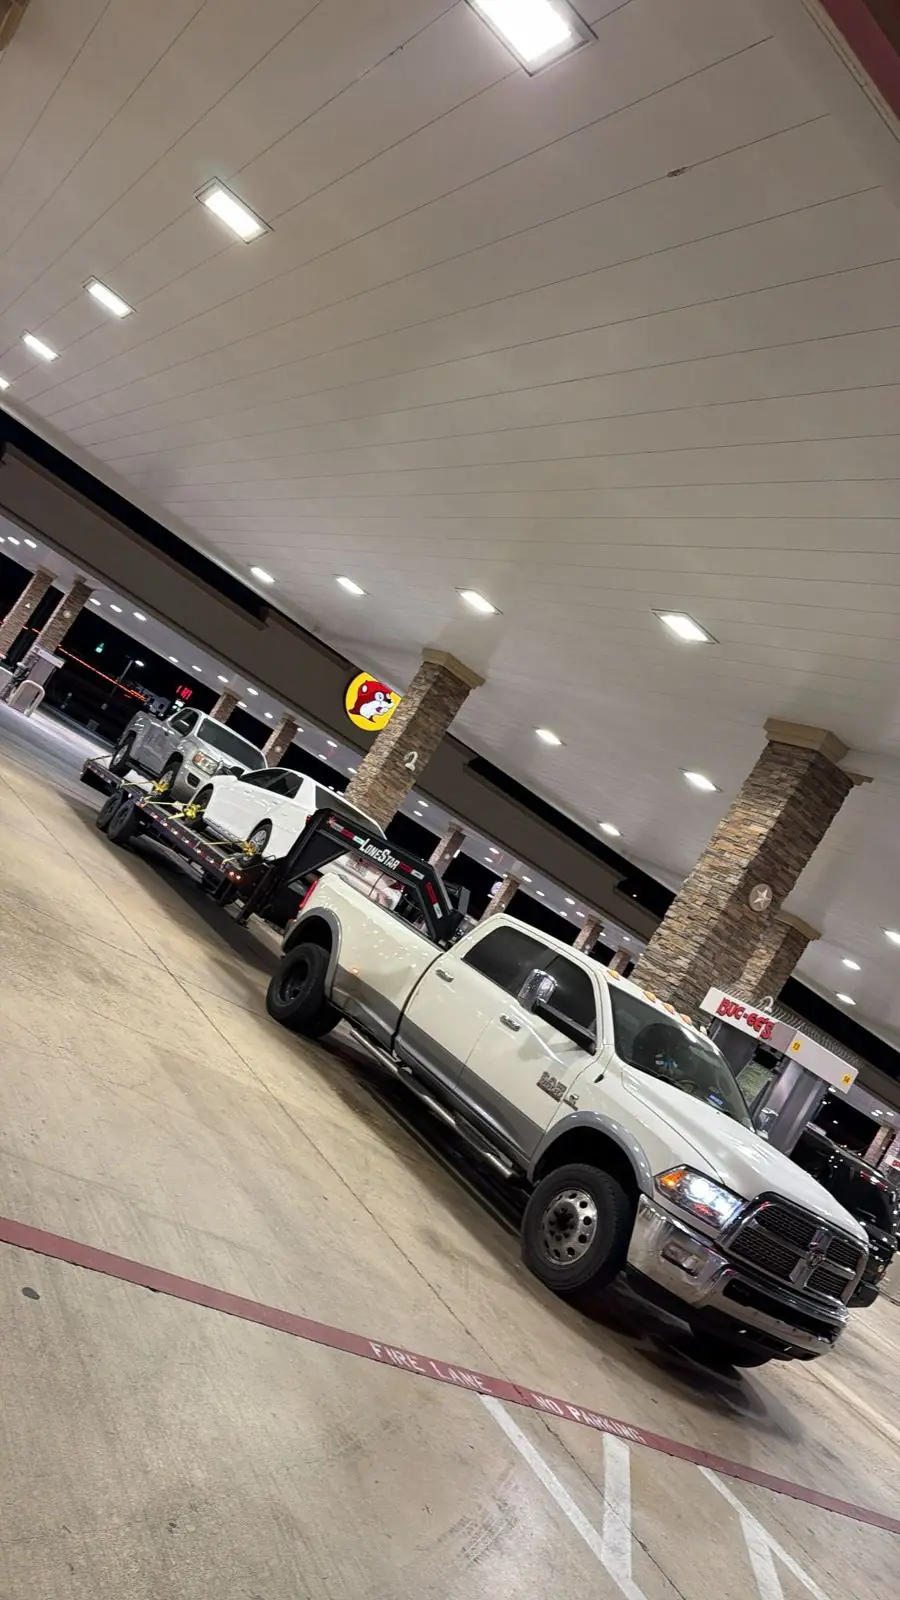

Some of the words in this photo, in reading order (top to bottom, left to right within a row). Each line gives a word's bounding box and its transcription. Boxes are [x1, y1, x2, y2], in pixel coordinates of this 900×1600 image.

[359, 838, 400, 870] LONESTAR
[368, 1341, 426, 1372] FIRE
[430, 1361, 492, 1393] LANE
[531, 1393, 563, 1415] NO
[567, 1405, 646, 1443] PARKING
